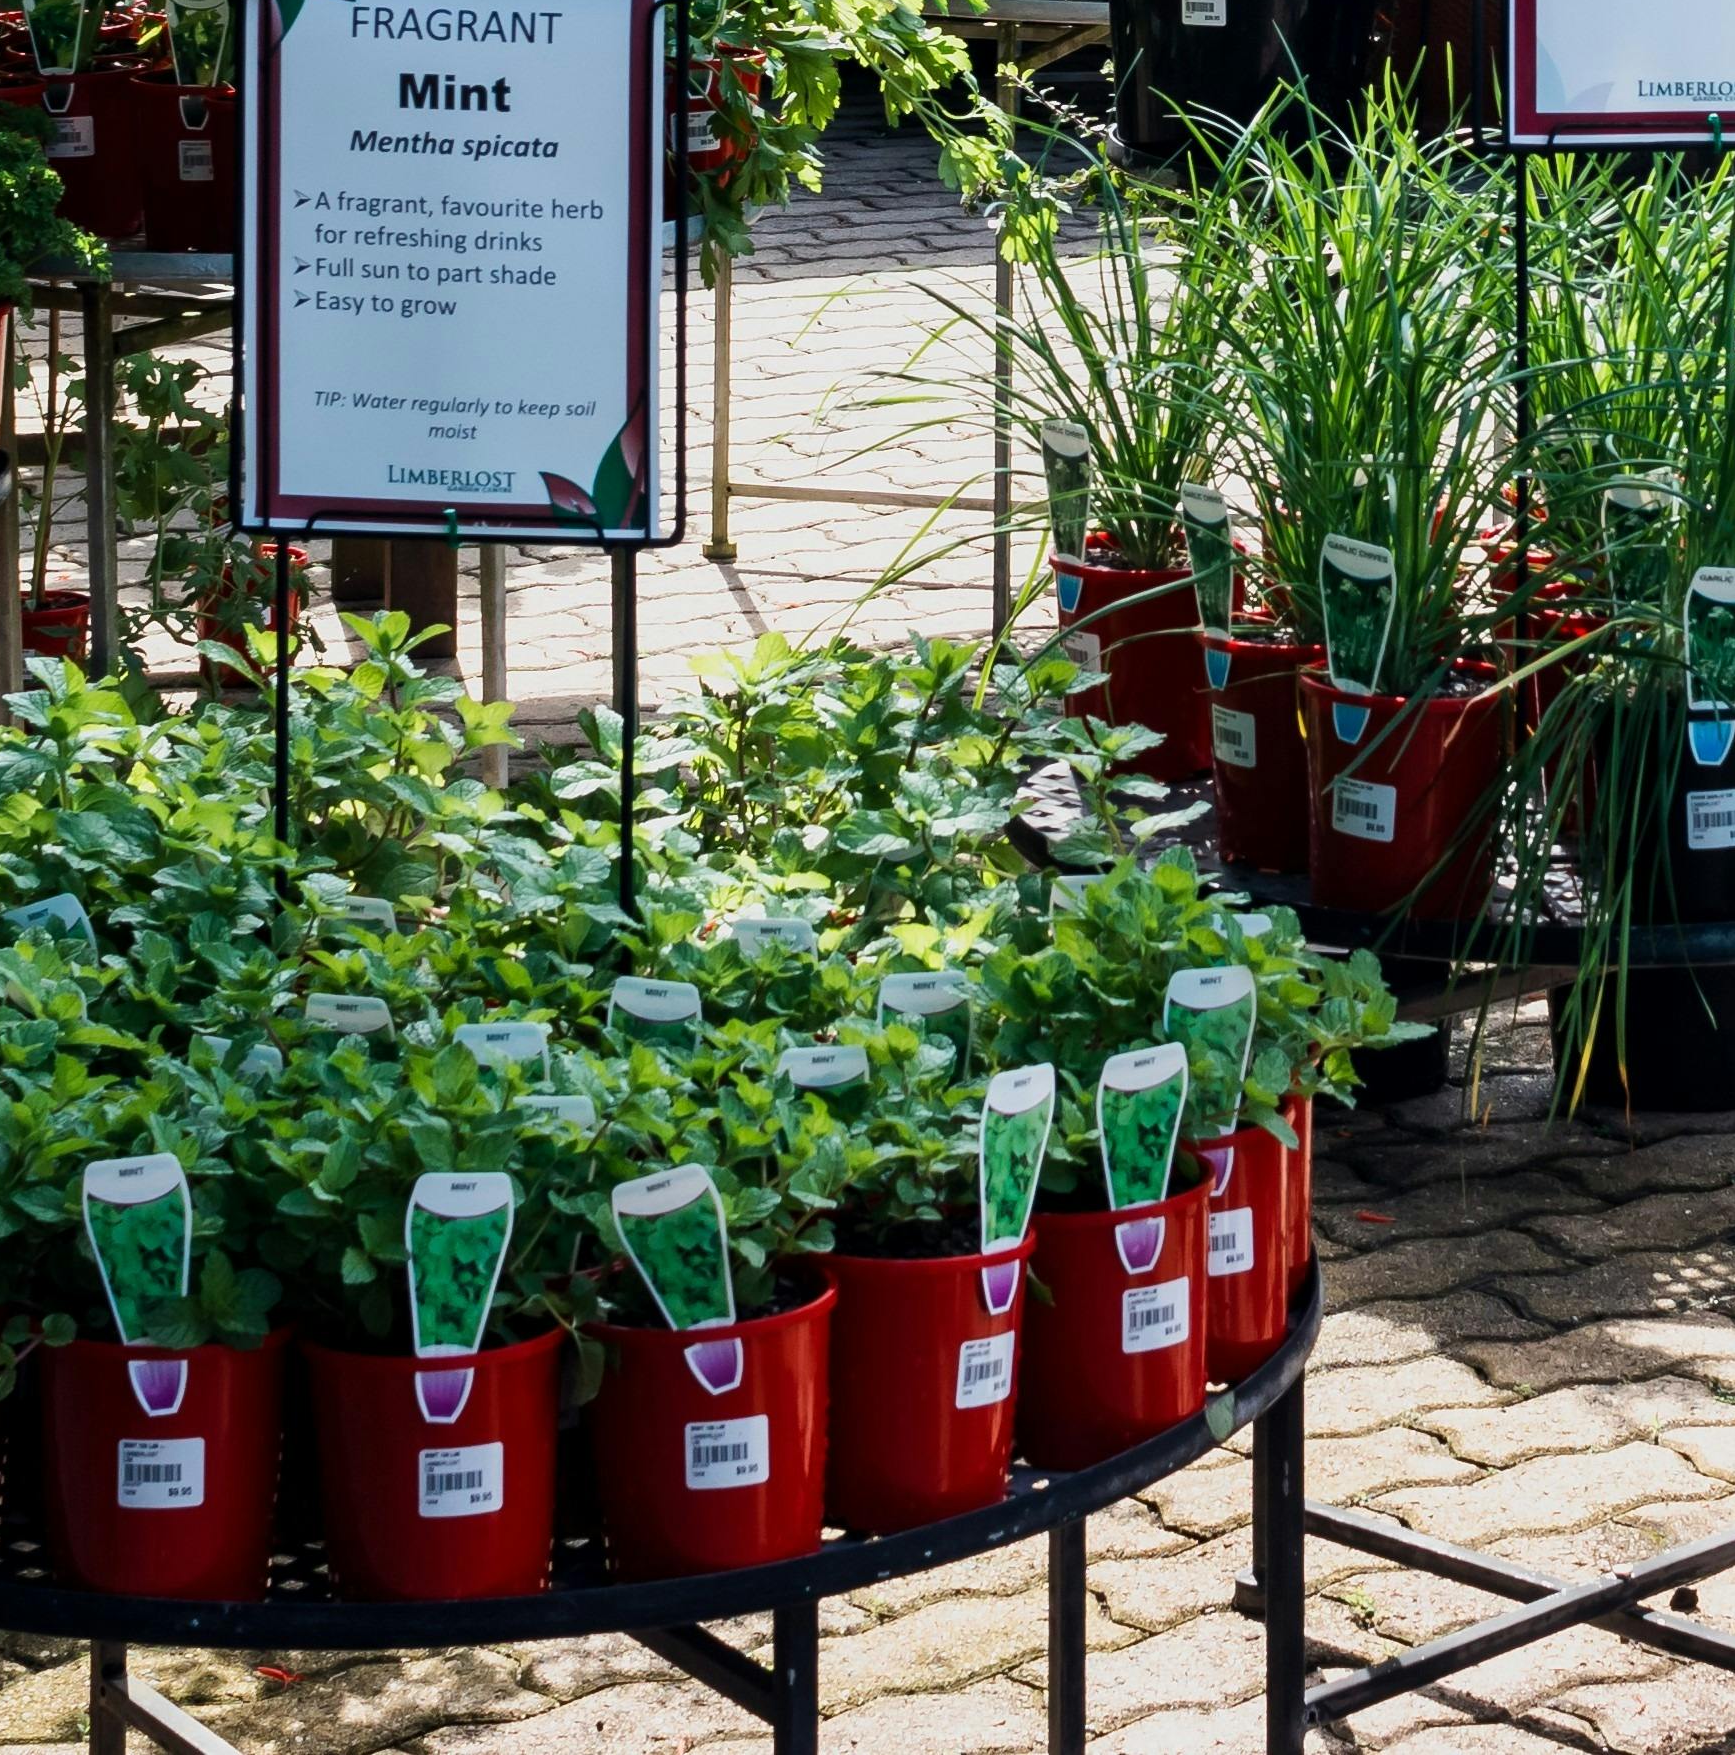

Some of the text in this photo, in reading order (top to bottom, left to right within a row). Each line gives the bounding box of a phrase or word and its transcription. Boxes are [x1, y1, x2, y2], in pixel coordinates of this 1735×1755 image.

[350, 6, 563, 45] FRAGRANT
[398, 72, 512, 113] Mint
[349, 129, 559, 162] Mentha spicata
[314, 191, 604, 221] A fragrant, favourite herb
[314, 223, 543, 253] for refreshing drinks
[315, 257, 557, 288] Full sun to part shade
[315, 291, 456, 317] Easy to grow
[314, 390, 595, 420] TIP: Water regularly to keep soil
[428, 422, 476, 439] moist
[387, 463, 516, 489] LIMBERLOST
[1328, 541, 1387, 562] GARLIC CHIVES
[1699, 573, 1733, 583] GARLIC
[912, 981, 937, 990] MINT
[1199, 976, 1221, 985] MINT
[645, 987, 668, 997] MINT
[486, 1033, 510, 1041] MINT
[811, 1055, 835, 1063] MINT
[1133, 1057, 1156, 1066] MINT
[119, 1167, 144, 1177] MINT
[450, 1182, 477, 1191] MINT
[646, 1179, 670, 1192] MINT
